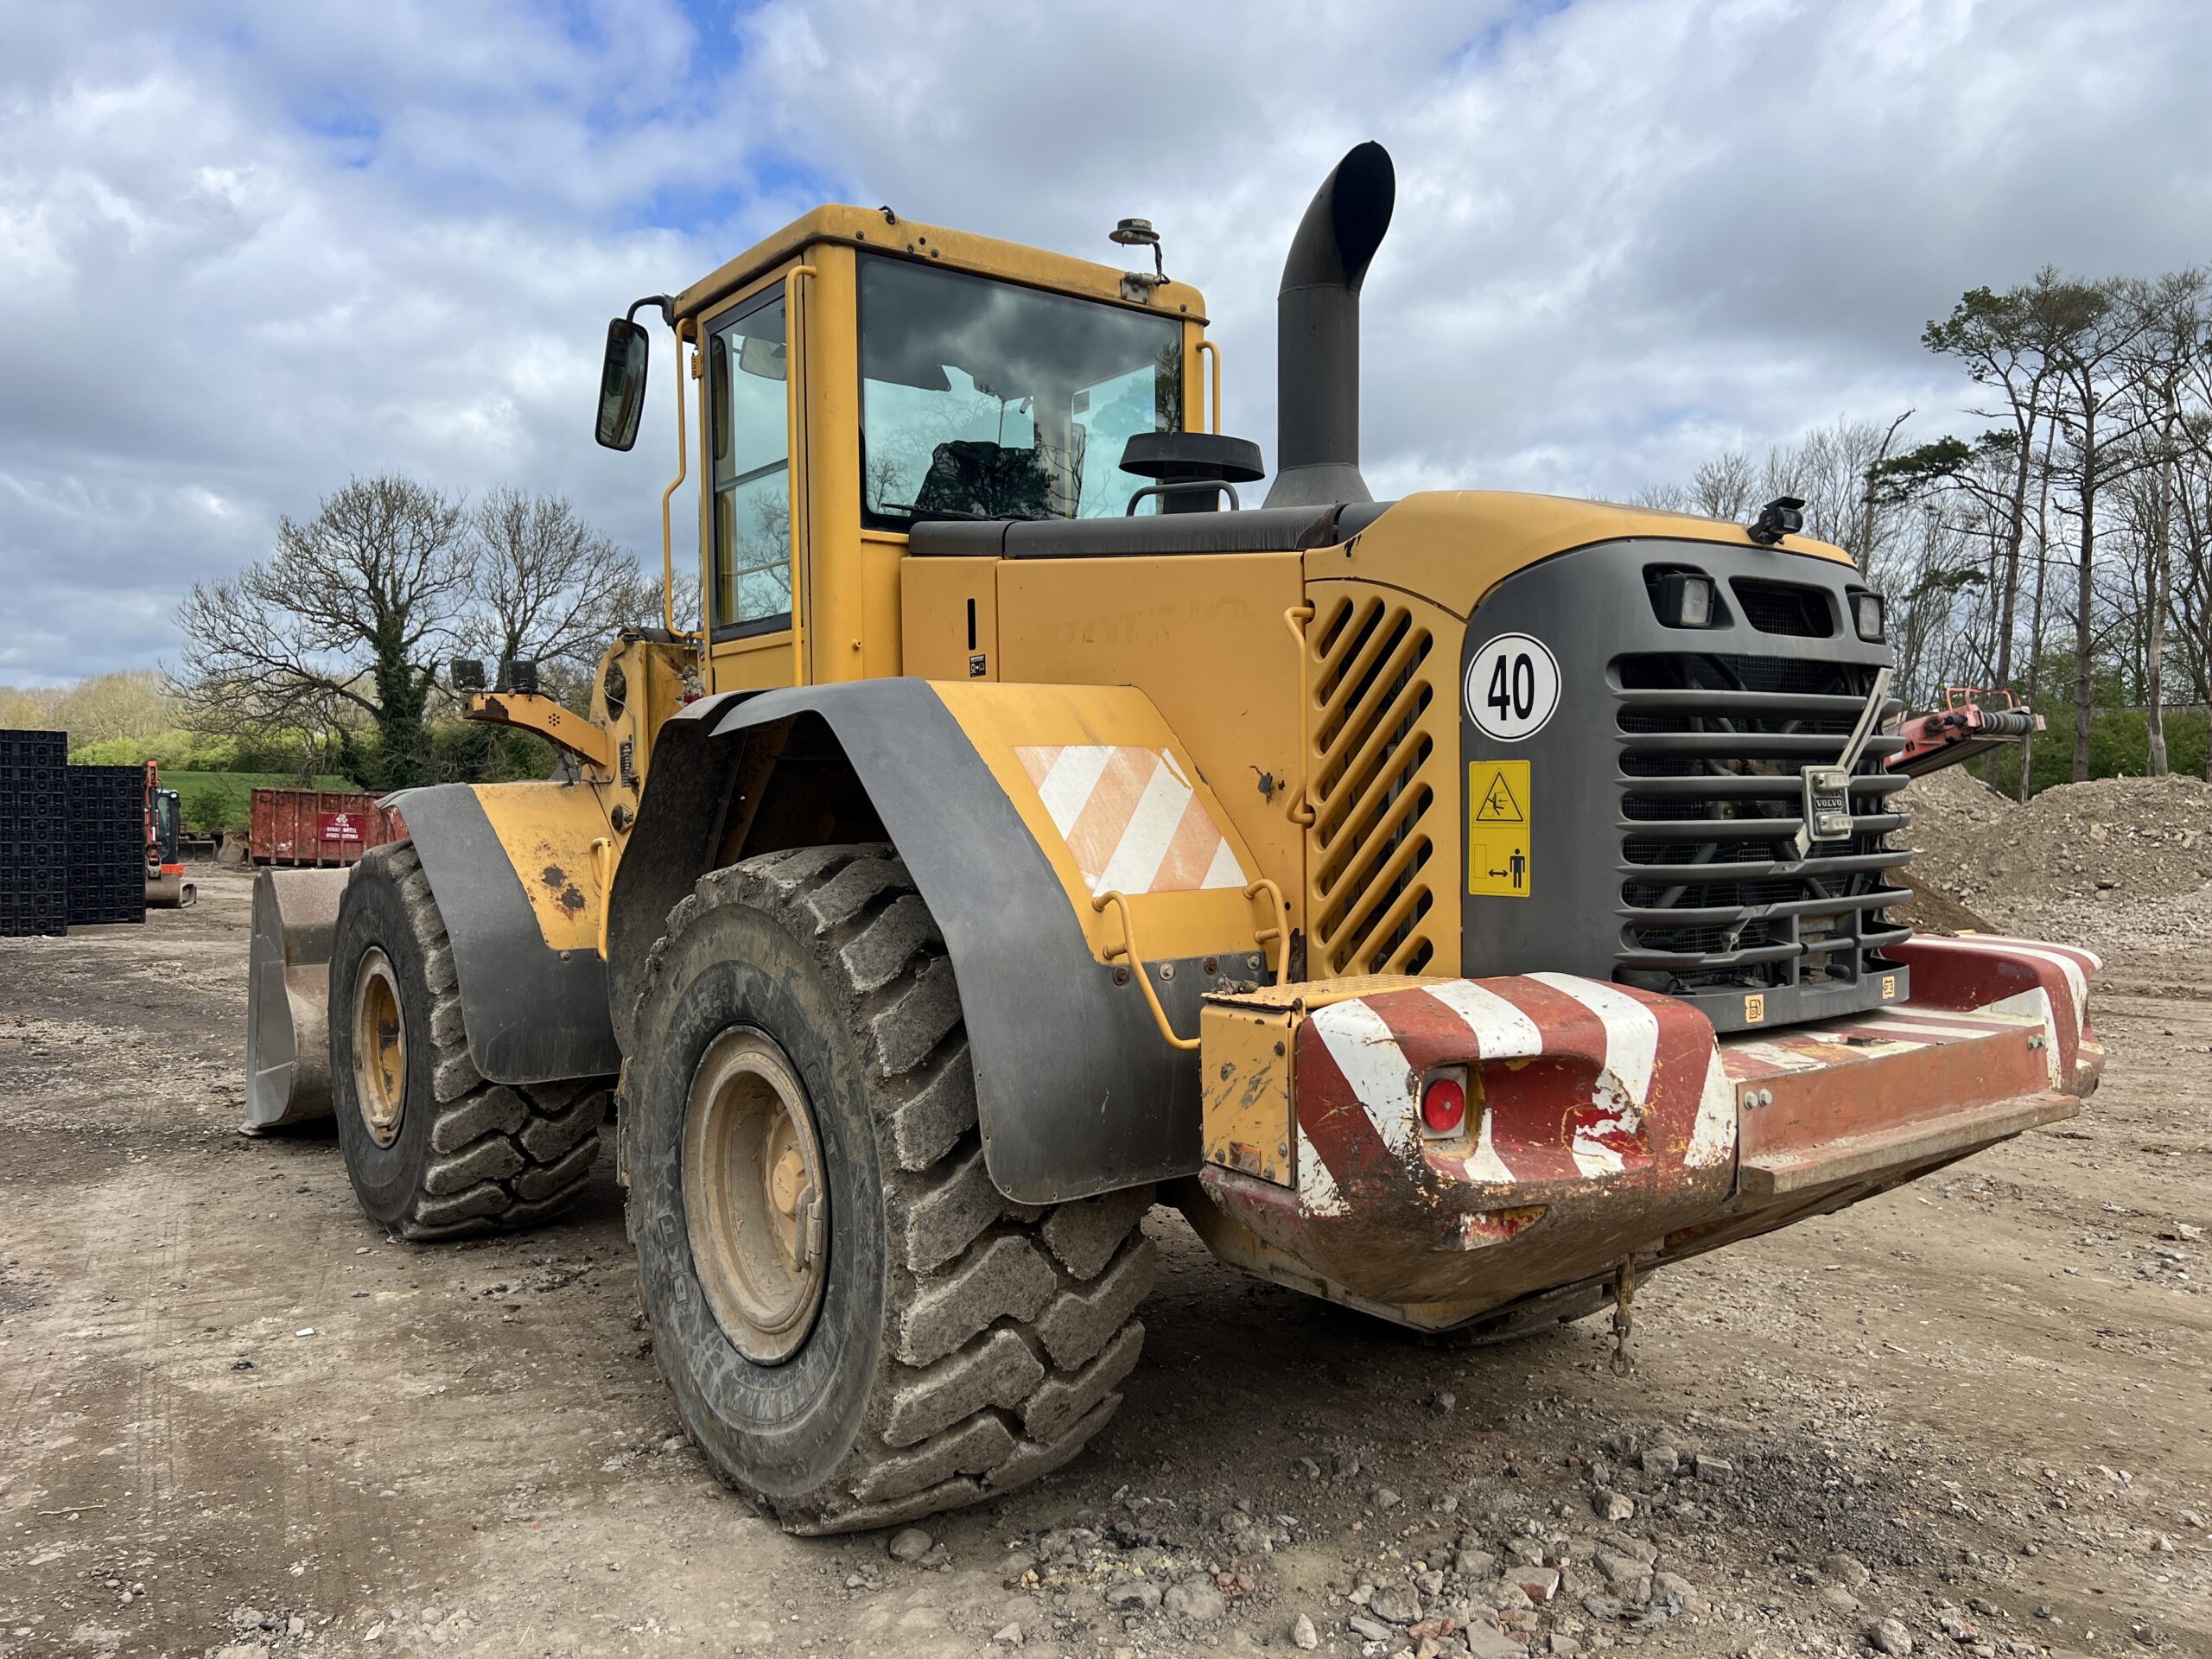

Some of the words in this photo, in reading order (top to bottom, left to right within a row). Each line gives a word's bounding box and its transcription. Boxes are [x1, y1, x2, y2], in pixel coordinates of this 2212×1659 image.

[1488, 653, 1535, 721] 40
[804, 1062, 844, 1163] BKT
[660, 1217, 688, 1304] BKT
